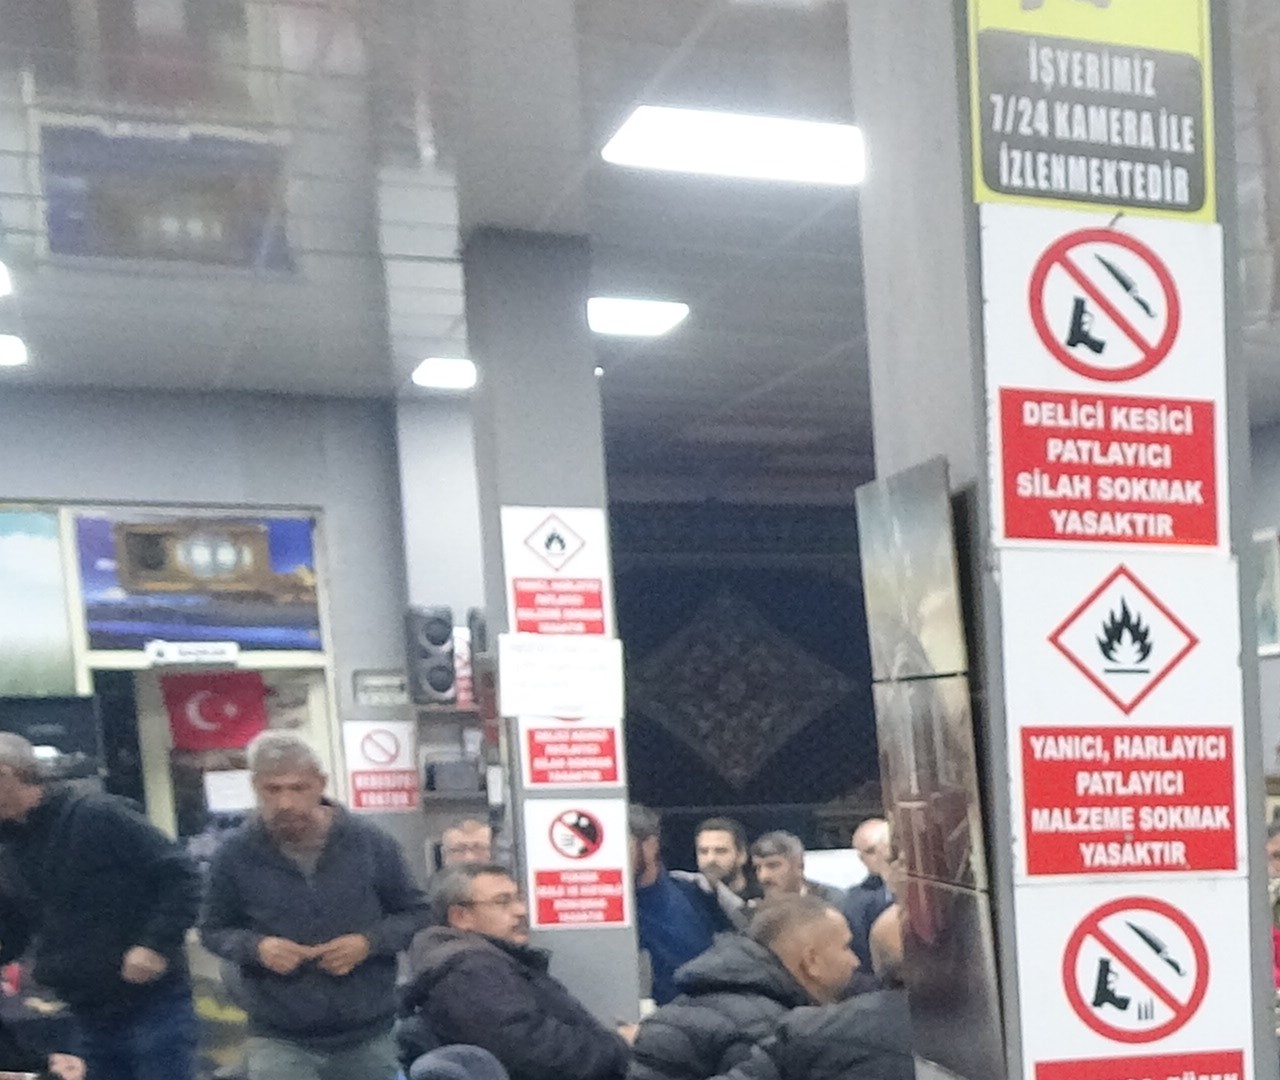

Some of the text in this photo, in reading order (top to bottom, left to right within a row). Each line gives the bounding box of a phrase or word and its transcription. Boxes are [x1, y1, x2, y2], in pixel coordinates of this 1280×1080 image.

[1028, 37, 1156, 98] İŞYERİMİZ
[989, 93, 1195, 154] 7/24 KAMERA İLE
[1000, 141, 1190, 206] İZLENMEKTEDİR
[1022, 399, 1193, 435] DELİCİ KESİCİ
[1046, 437, 1172, 469] PATLAYICI
[1016, 467, 1204, 504] SİLAH SOKMAK
[1049, 509, 1174, 537] YASAKTIR
[1029, 735, 1226, 764] YANICI, HARLAYICI
[1075, 770, 1184, 796] PATLAYICI
[1031, 805, 1230, 832] MALZEME SOKMAK
[1079, 841, 1187, 867] YASAKTIR
